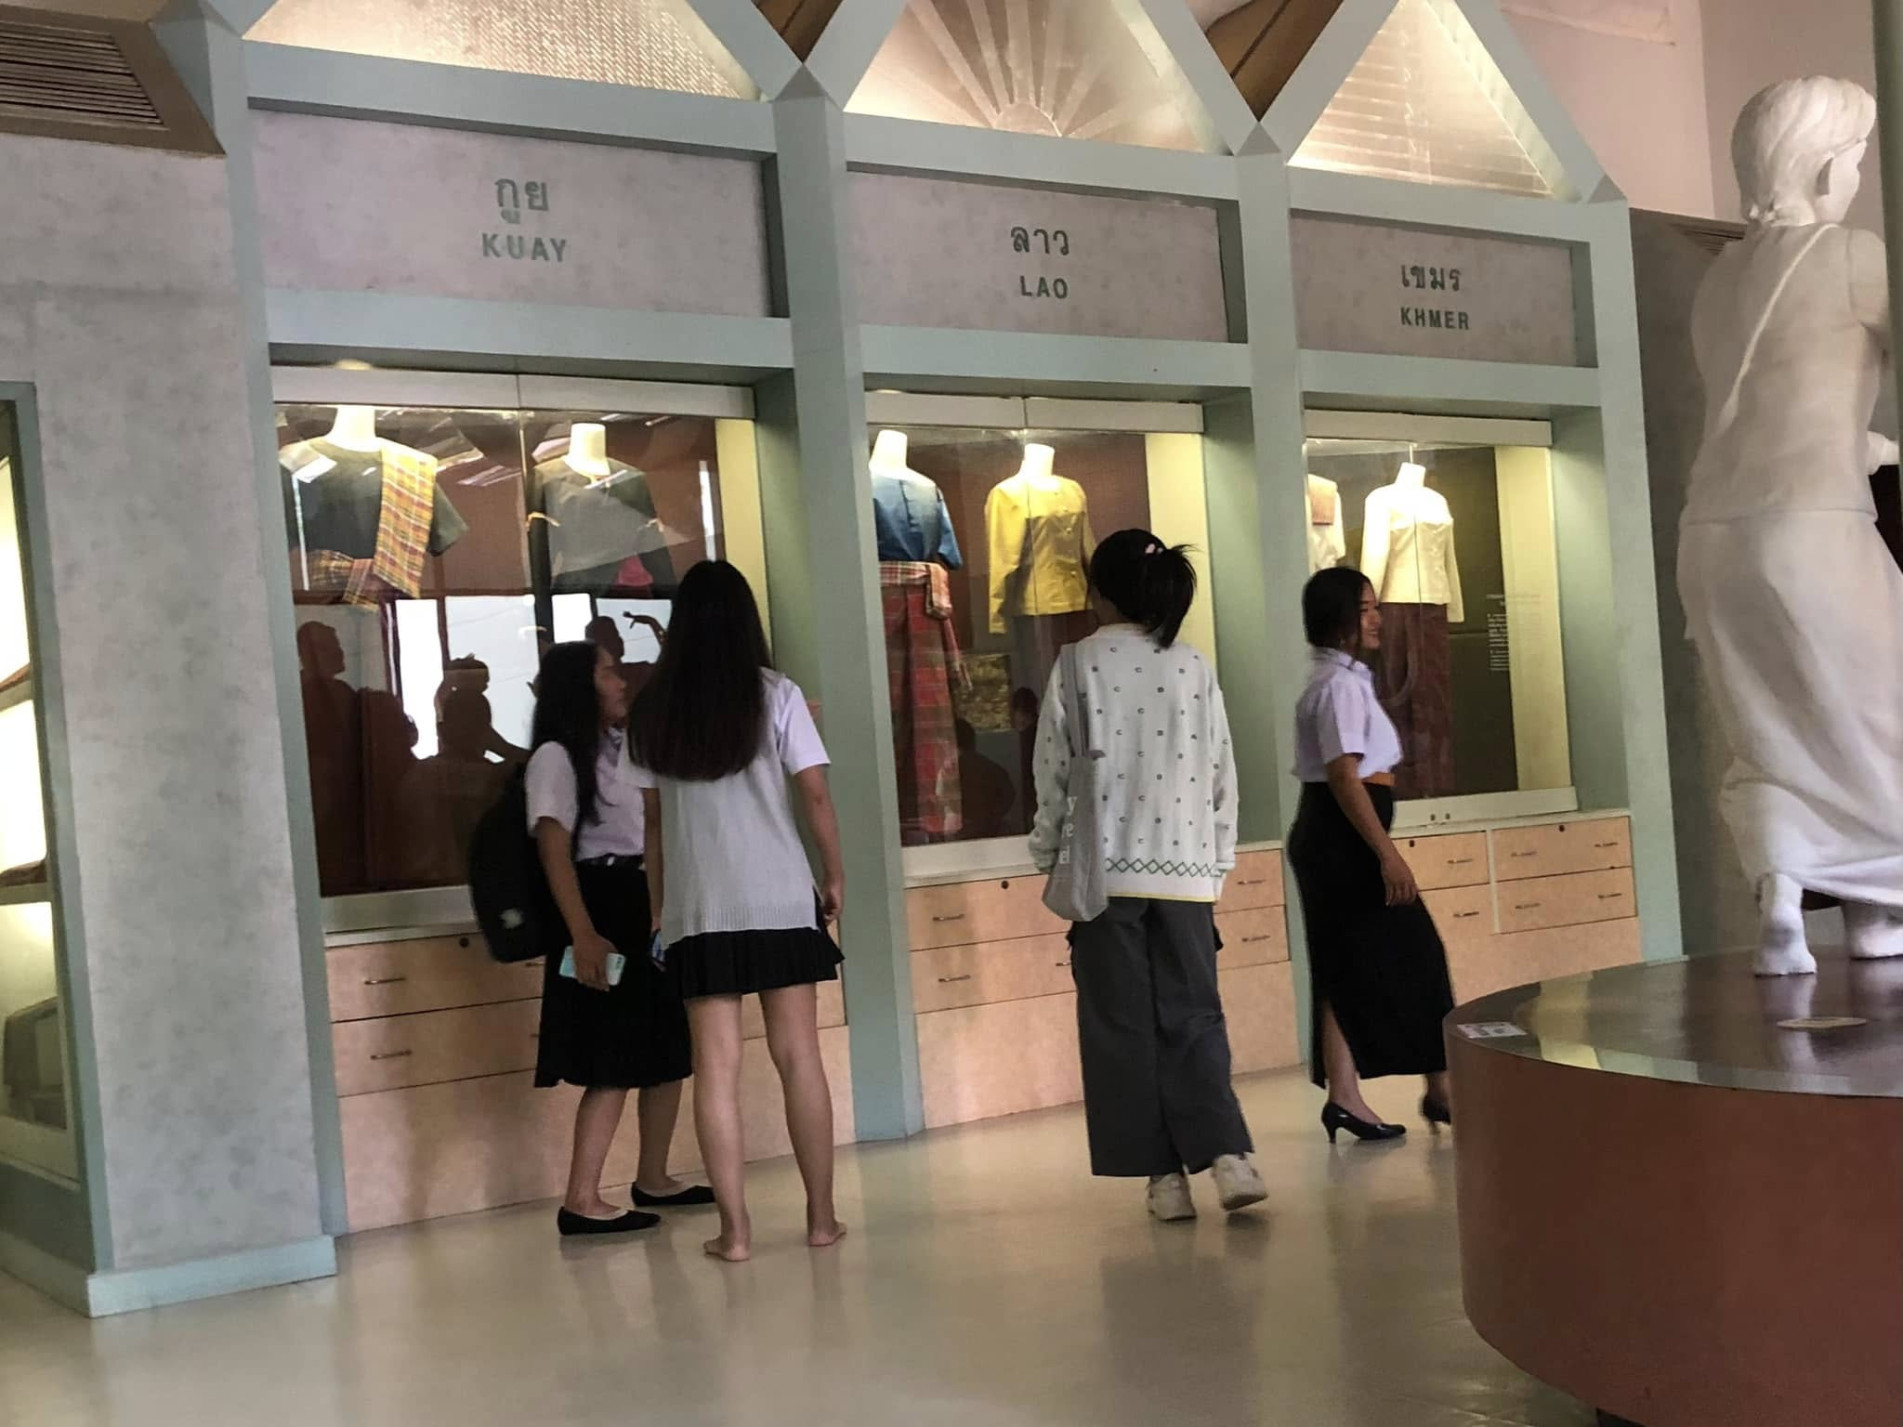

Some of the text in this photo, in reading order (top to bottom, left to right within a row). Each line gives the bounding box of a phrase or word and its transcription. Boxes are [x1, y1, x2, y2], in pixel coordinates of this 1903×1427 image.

[494, 178, 549, 225] กูย
[482, 233, 566, 262] KUAY
[1011, 226, 1069, 256] ลาว
[1020, 275, 1068, 299] LAO
[1401, 264, 1461, 292] เขมร
[1401, 306, 1469, 330] KHMER
